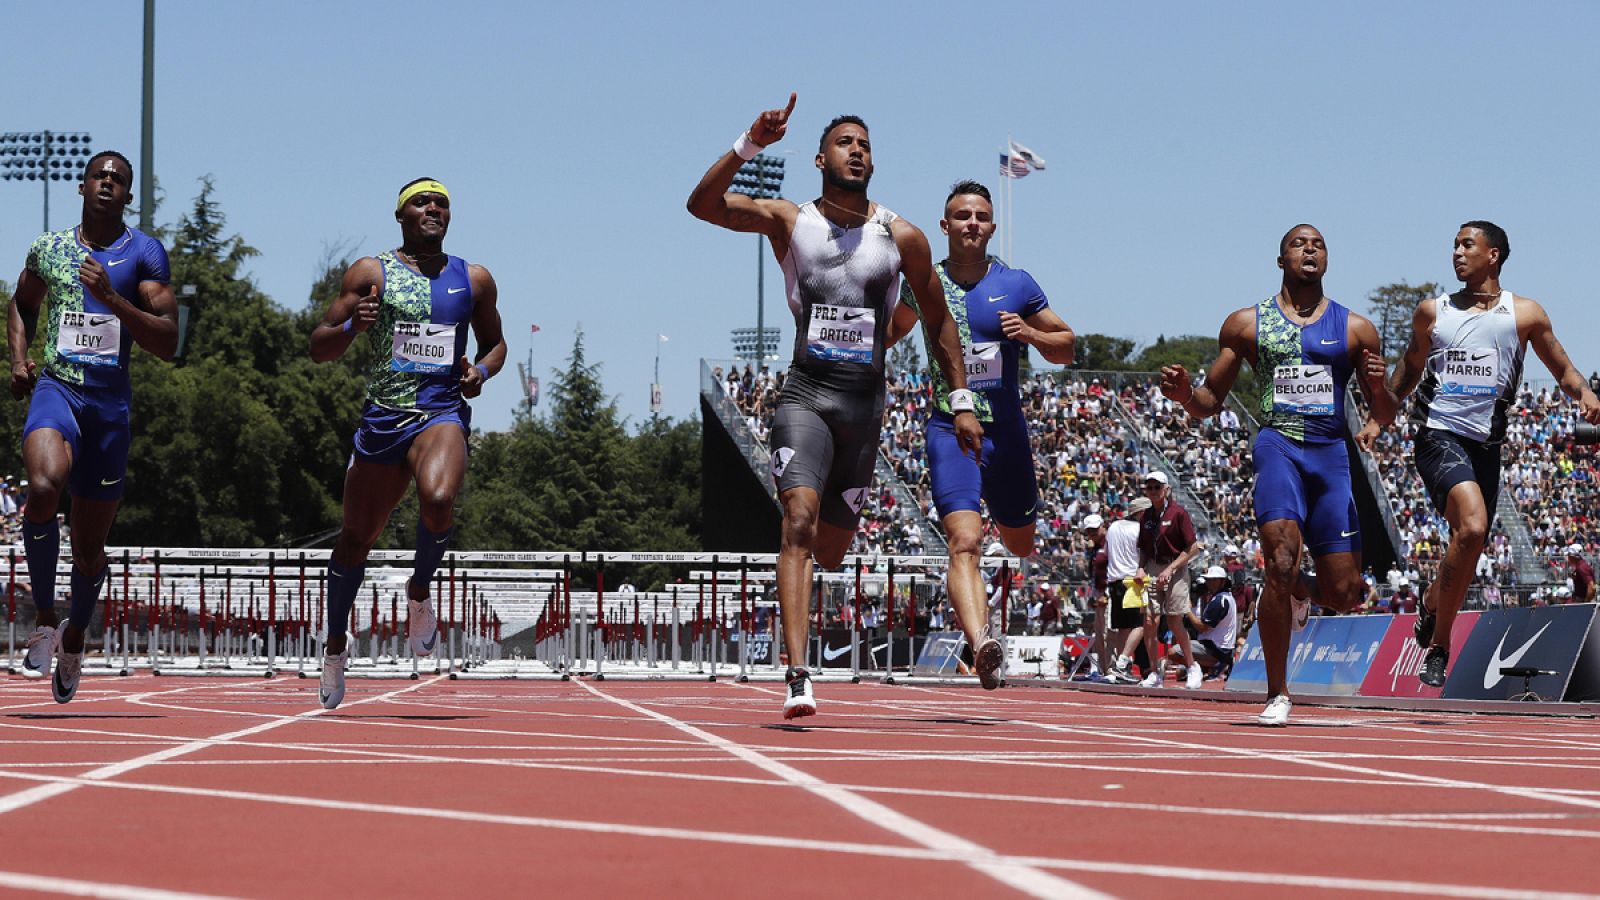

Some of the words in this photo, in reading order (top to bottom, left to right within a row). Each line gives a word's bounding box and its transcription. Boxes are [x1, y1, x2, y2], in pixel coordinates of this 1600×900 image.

[64, 312, 85, 327] PRE
[815, 305, 838, 321] PRE
[398, 323, 421, 337] PRE
[820, 327, 864, 344] ORTEGA
[75, 333, 103, 348] LEVY
[402, 341, 445, 358] MCLEOD
[831, 348, 867, 361] Eugene
[1446, 350, 1468, 362] PRE
[1278, 367, 1300, 379] PRE
[1446, 364, 1493, 377] HARRIS
[1275, 383, 1333, 394] BELOCIAN
[1462, 386, 1492, 395] Eugene
[774, 450, 784, 470] 4
[853, 488, 865, 508] 4
[1018, 647, 1048, 659] MILK
